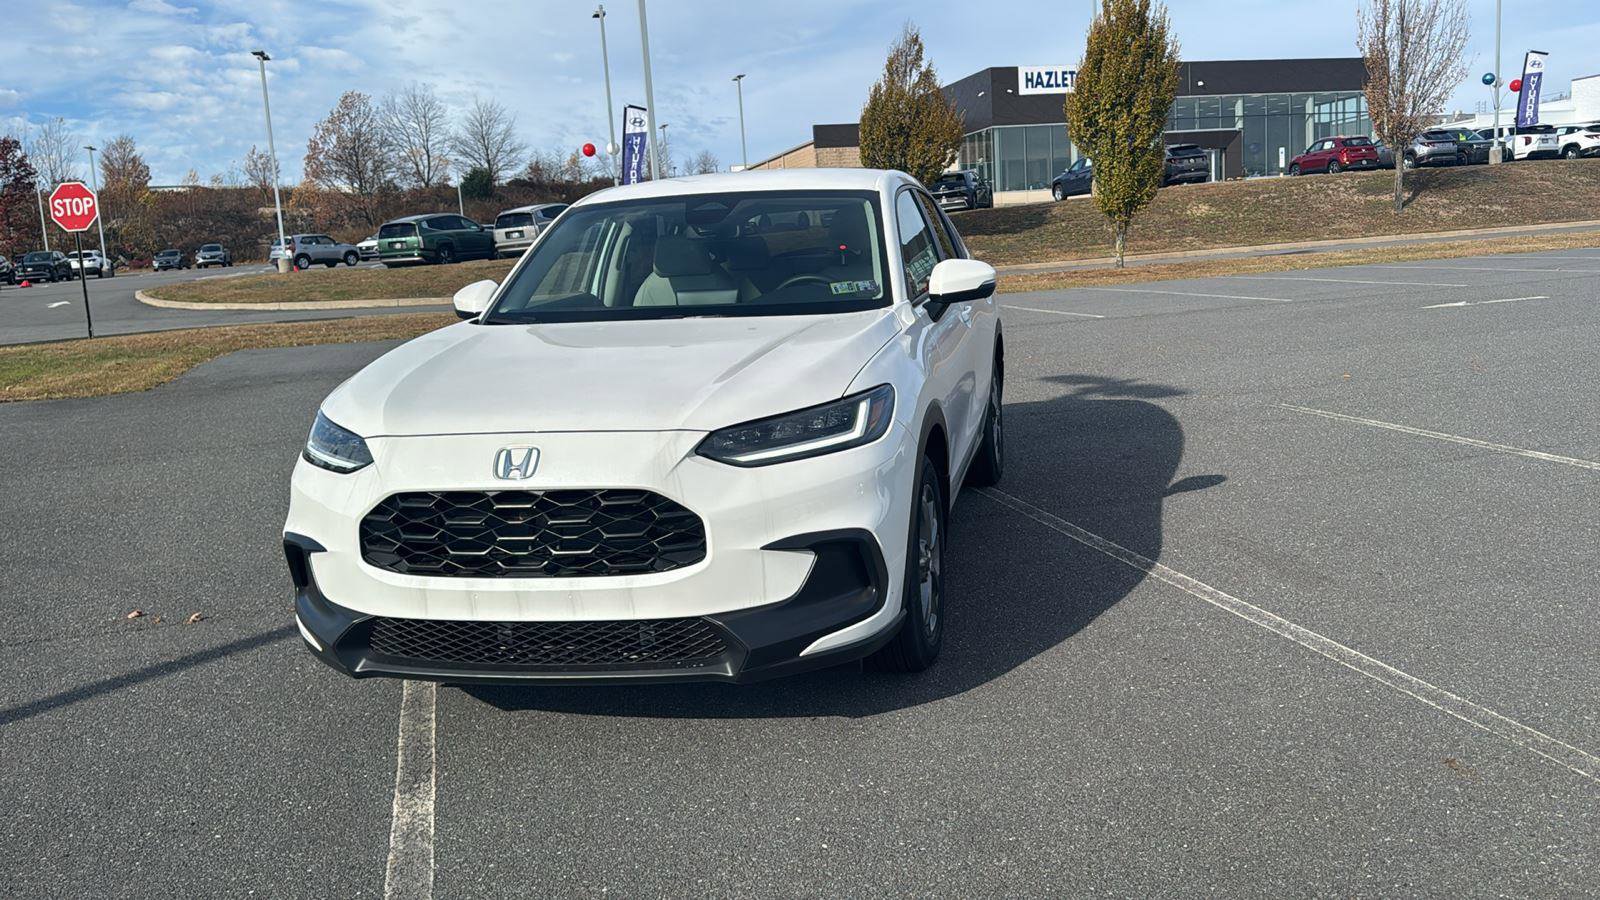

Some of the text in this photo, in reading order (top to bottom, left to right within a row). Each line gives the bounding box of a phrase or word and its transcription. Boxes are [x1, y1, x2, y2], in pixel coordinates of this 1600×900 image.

[1025, 71, 1078, 88] HAZLET
[630, 136, 641, 185] HYUNDA
[53, 197, 93, 217] STOP
